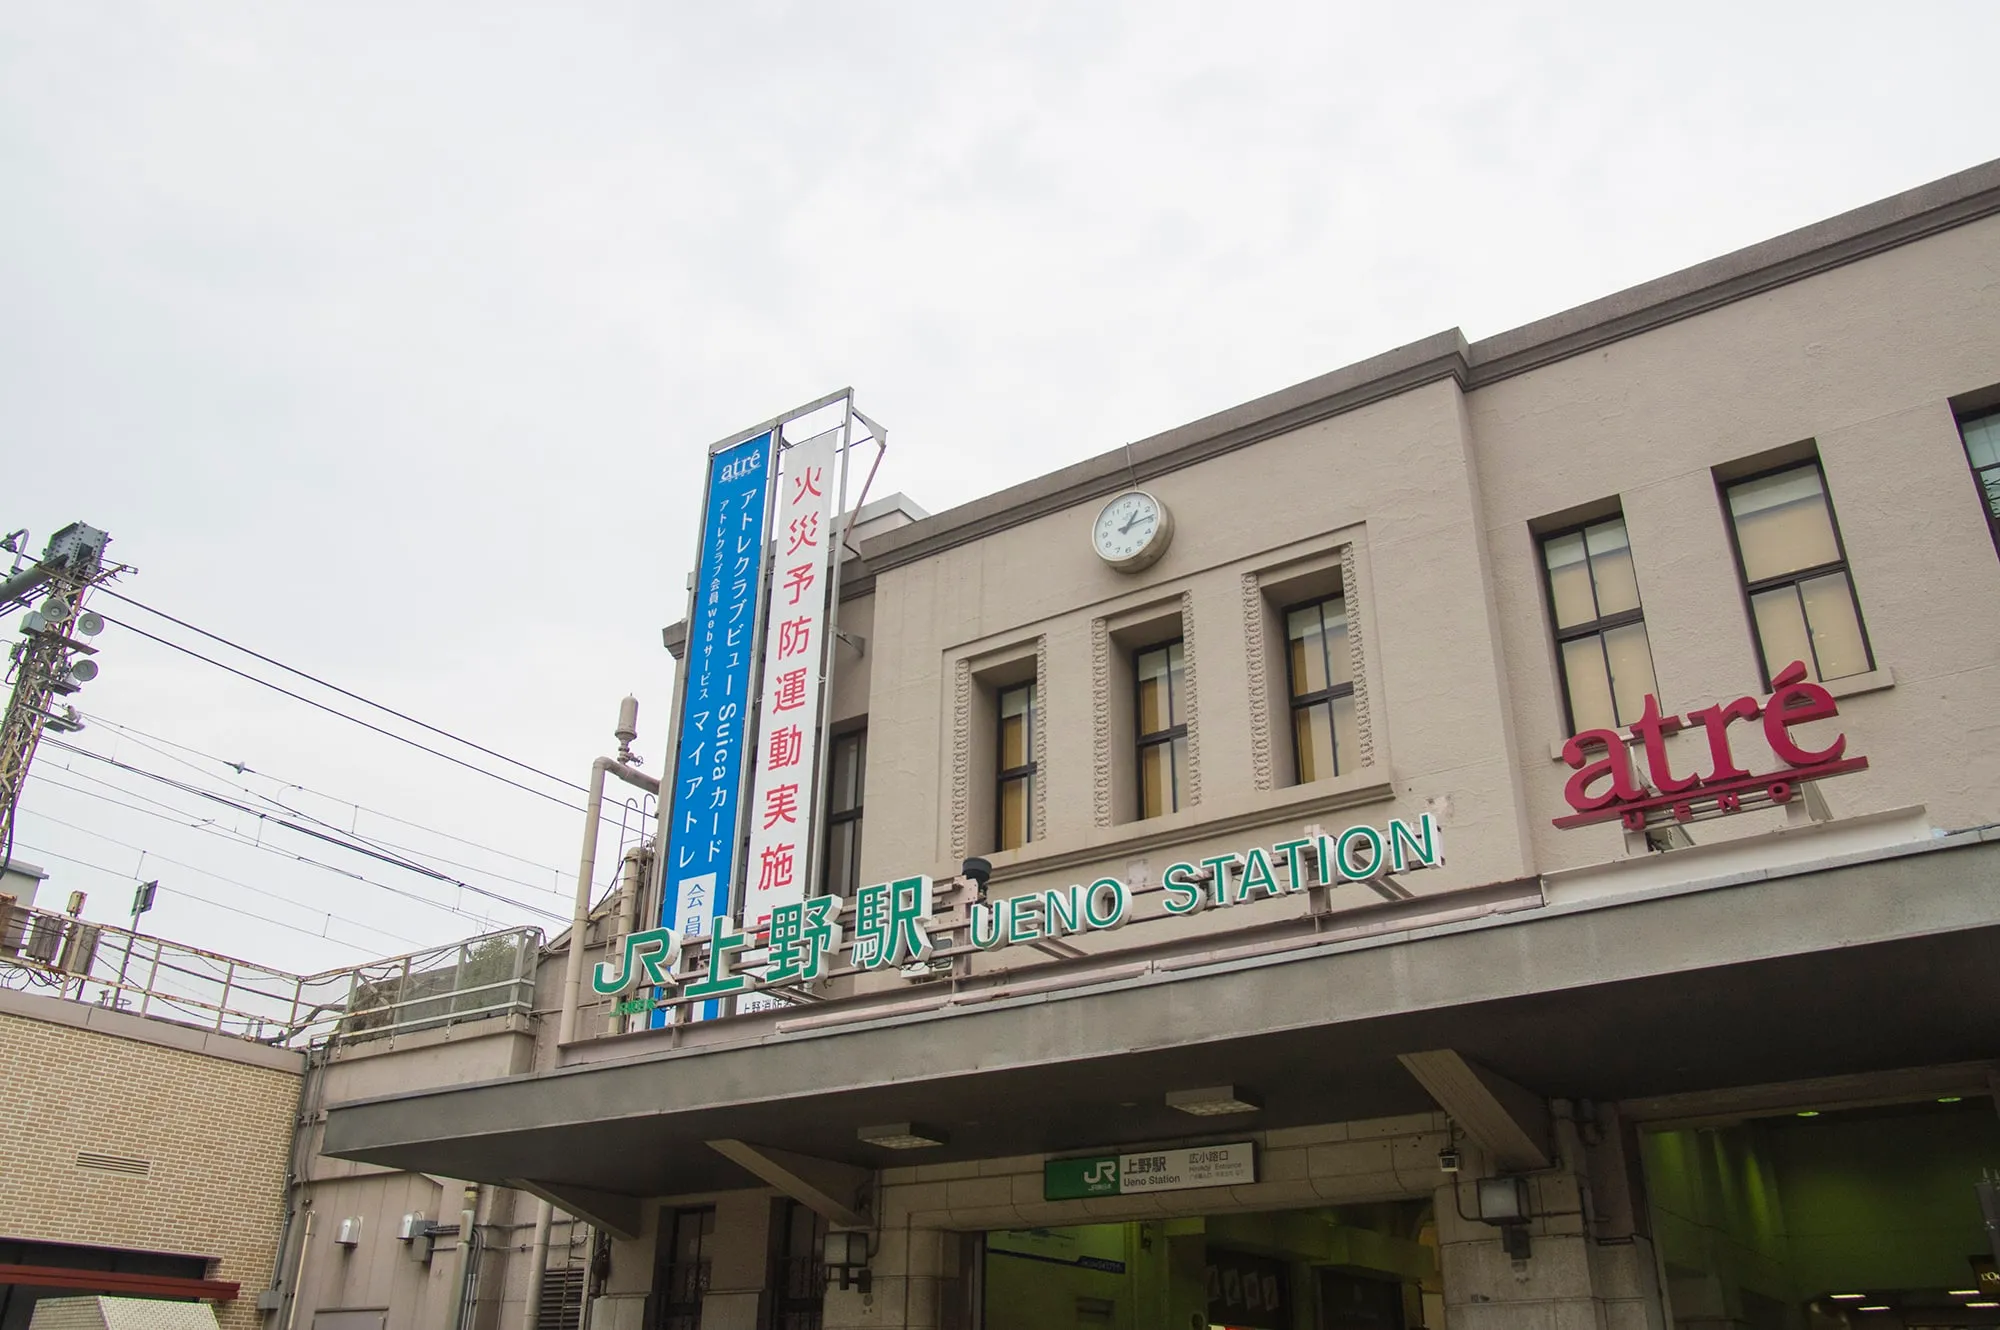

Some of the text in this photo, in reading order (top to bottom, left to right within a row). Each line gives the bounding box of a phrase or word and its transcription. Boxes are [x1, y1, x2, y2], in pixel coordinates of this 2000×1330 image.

[721, 449, 761, 480] atré
[1123, 501, 1132, 509] 12
[1104, 520, 1113, 528] 10
[1562, 660, 1846, 813] atré
[679, 710, 709, 869] マイアトレ
[1623, 782, 1793, 830] UENO
[970, 811, 1443, 950] UENO STATION
[1124, 1156, 1167, 1175] 上野駅
[1188, 1150, 1229, 1164] 広小路口
[1084, 1161, 1116, 1183] JR
[1123, 1177, 1147, 1187] Ueno
[1148, 1174, 1181, 1185] Station
